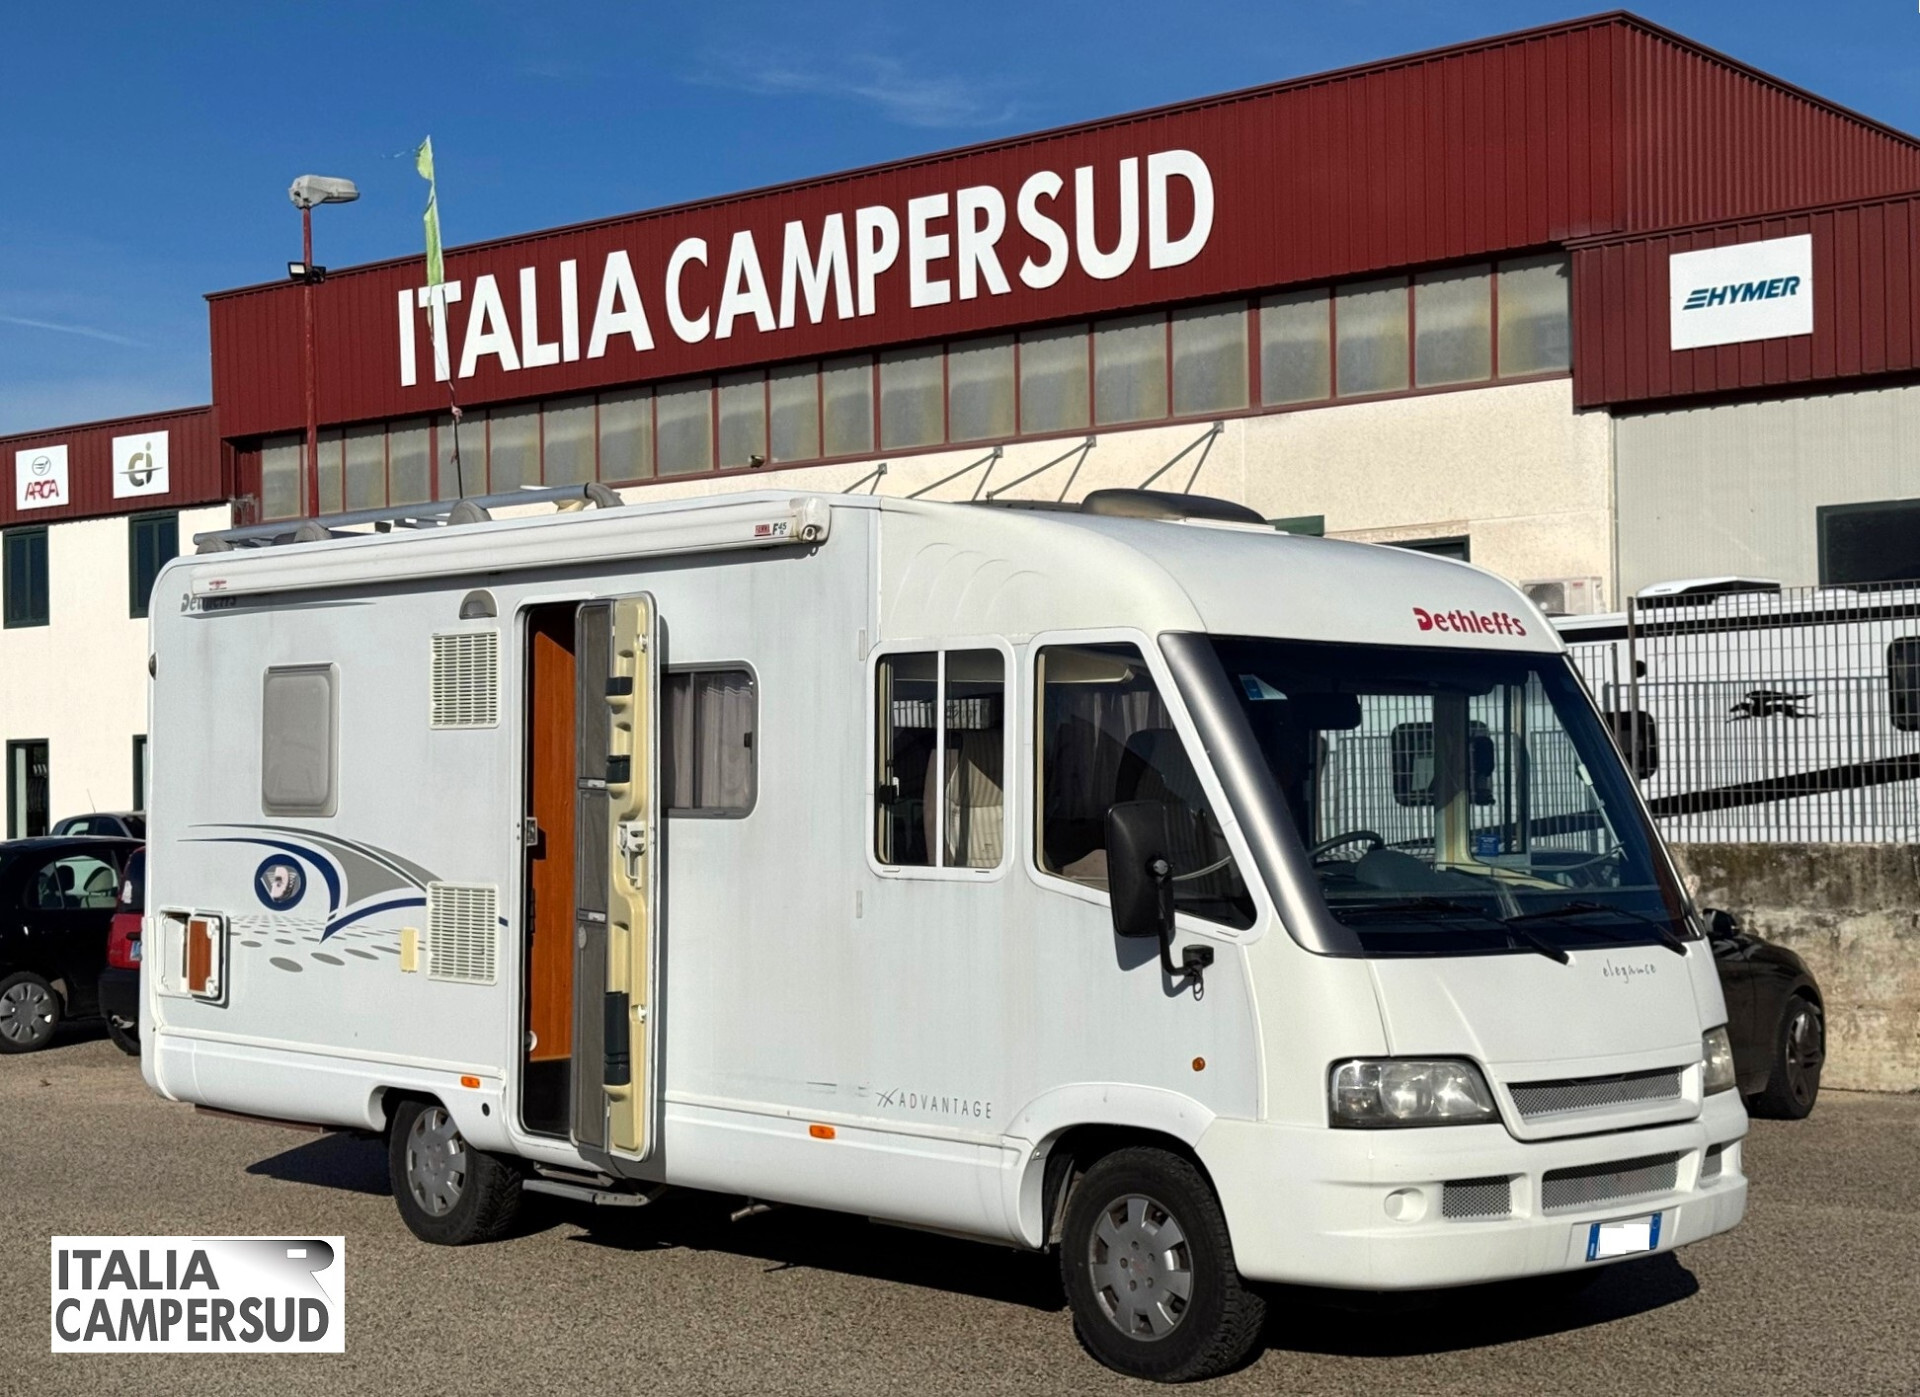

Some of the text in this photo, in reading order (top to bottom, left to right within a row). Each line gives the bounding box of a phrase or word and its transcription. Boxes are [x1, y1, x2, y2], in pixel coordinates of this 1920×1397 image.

[1706, 275, 1801, 307] HYMER
[398, 250, 654, 387] ITALIA
[25, 479, 60, 501] ARCA
[1412, 607, 1527, 636] Dethleffs
[1602, 958, 1656, 984] elegance
